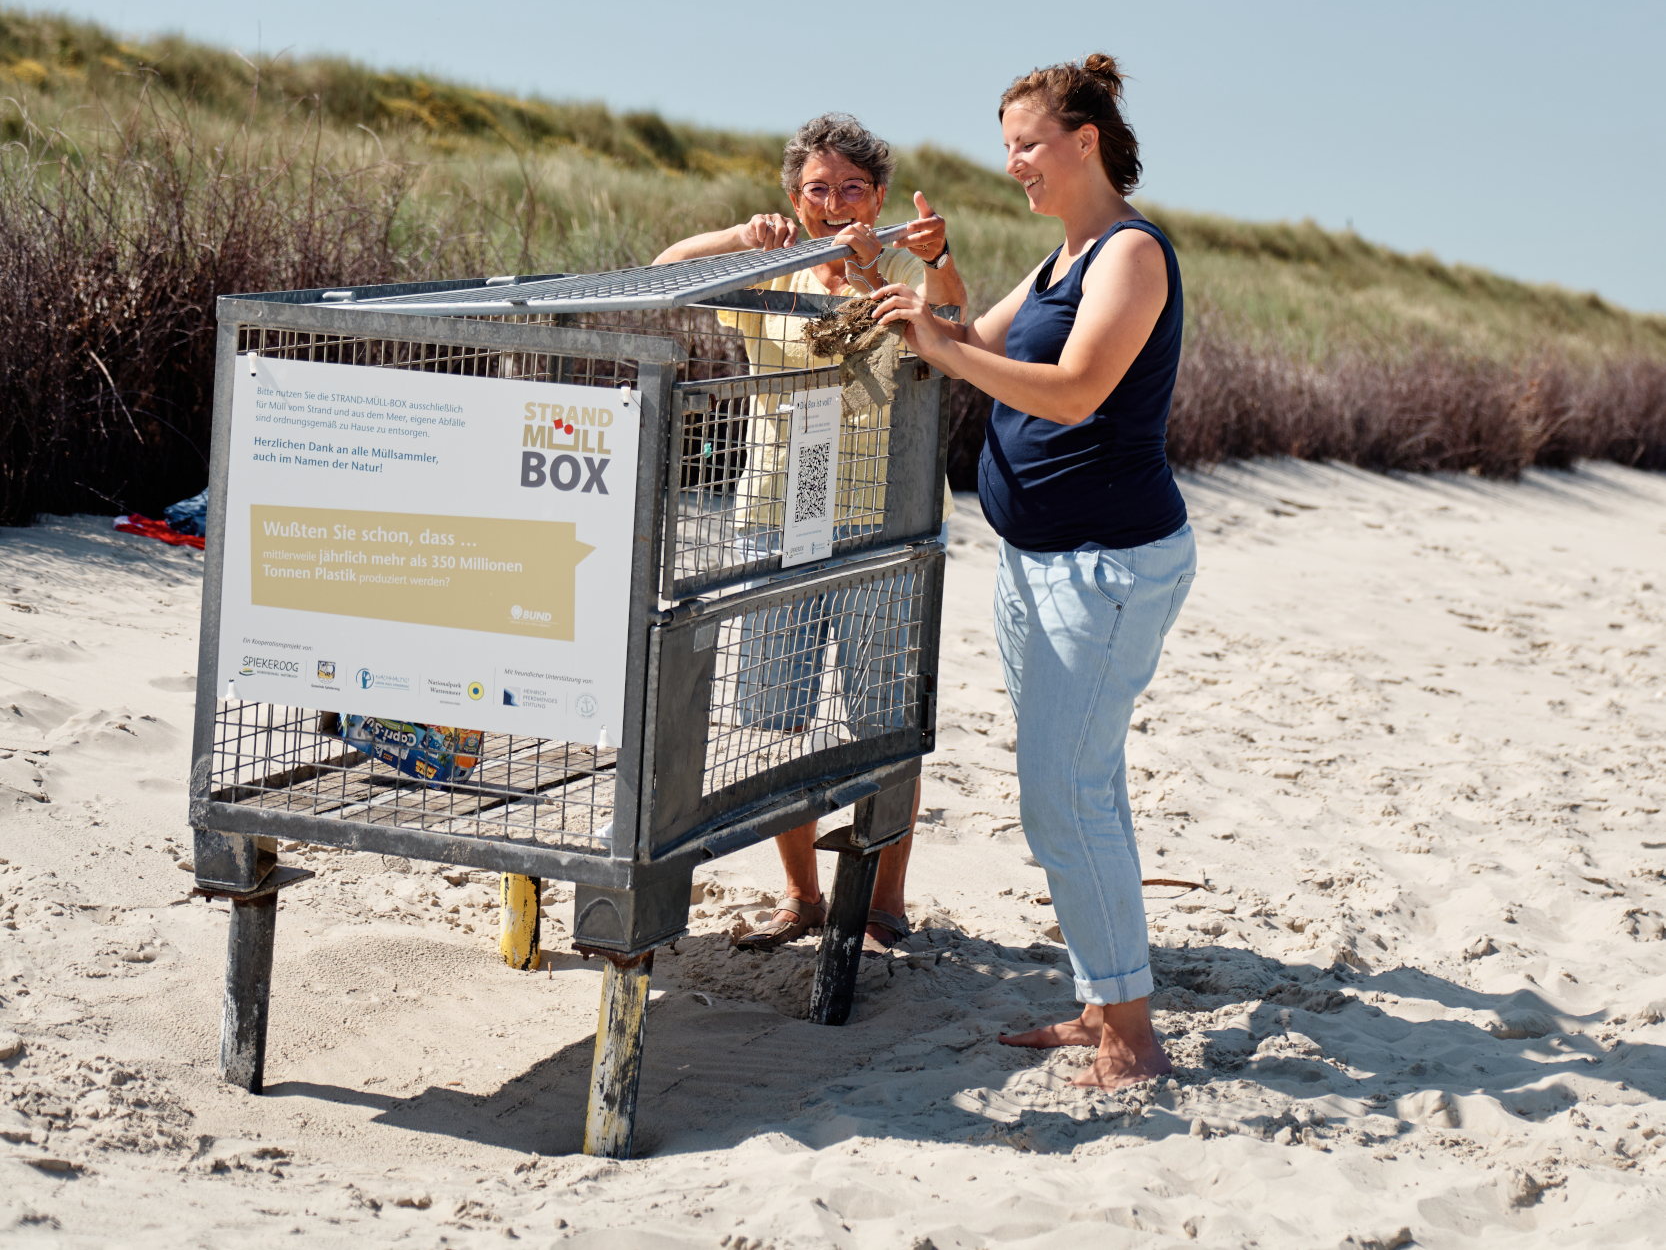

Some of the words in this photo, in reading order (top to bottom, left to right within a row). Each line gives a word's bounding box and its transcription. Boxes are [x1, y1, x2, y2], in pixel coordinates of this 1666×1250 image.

[257, 386, 274, 396] Bitte
[275, 390, 302, 398] nutzen
[304, 391, 316, 400] Sie
[317, 392, 329, 402] die
[331, 393, 407, 408] STRAND-MÜLL-BOX
[409, 402, 463, 413] ausschließlich
[255, 413, 272, 423] sind
[273, 416, 338, 429] ordnungsgemäß
[351, 422, 375, 433] Hause
[376, 426, 386, 434] zu
[388, 427, 430, 439] entsorgen.
[256, 400, 268, 409] für
[269, 401, 287, 411] Müll
[288, 404, 305, 412] vom
[307, 404, 332, 415] Strand
[334, 408, 350, 417] und
[351, 410, 365, 418] aus
[366, 410, 384, 420] dem
[386, 412, 408, 423] Meer,
[410, 415, 437, 426] eigene
[438, 417, 466, 428] Abfälle
[524, 402, 613, 427] STRAND
[522, 419, 611, 455] MÜLL
[253, 452, 276, 462] auch
[279, 453, 292, 464] im
[294, 455, 329, 468] Namen
[332, 459, 349, 469] der
[352, 461, 383, 473] Natur!
[254, 436, 306, 450] Herzlichen
[308, 441, 334, 453] Dank
[336, 446, 349, 454] an
[351, 446, 369, 457] alle
[372, 448, 439, 465] Müllsammler,
[520, 451, 611, 495] BOX
[263, 521, 327, 539] Wußten
[333, 524, 357, 541] Sie
[362, 526, 414, 546] schon,
[419, 528, 455, 546] dass
[263, 550, 317, 562] mittlerweile
[319, 550, 367, 567] jährlich
[371, 553, 407, 566] mehr
[410, 554, 427, 568] als
[432, 555, 456, 569] 350
[460, 556, 523, 573] Millionen
[263, 565, 310, 579] Tonnen
[315, 567, 357, 582] Plastik
[359, 573, 408, 585] produziert
[410, 576, 451, 587] werden?
[523, 610, 552, 621] BUND
[428, 679, 462, 689] Nationalpark
[522, 701, 546, 709] STIFTUNG
